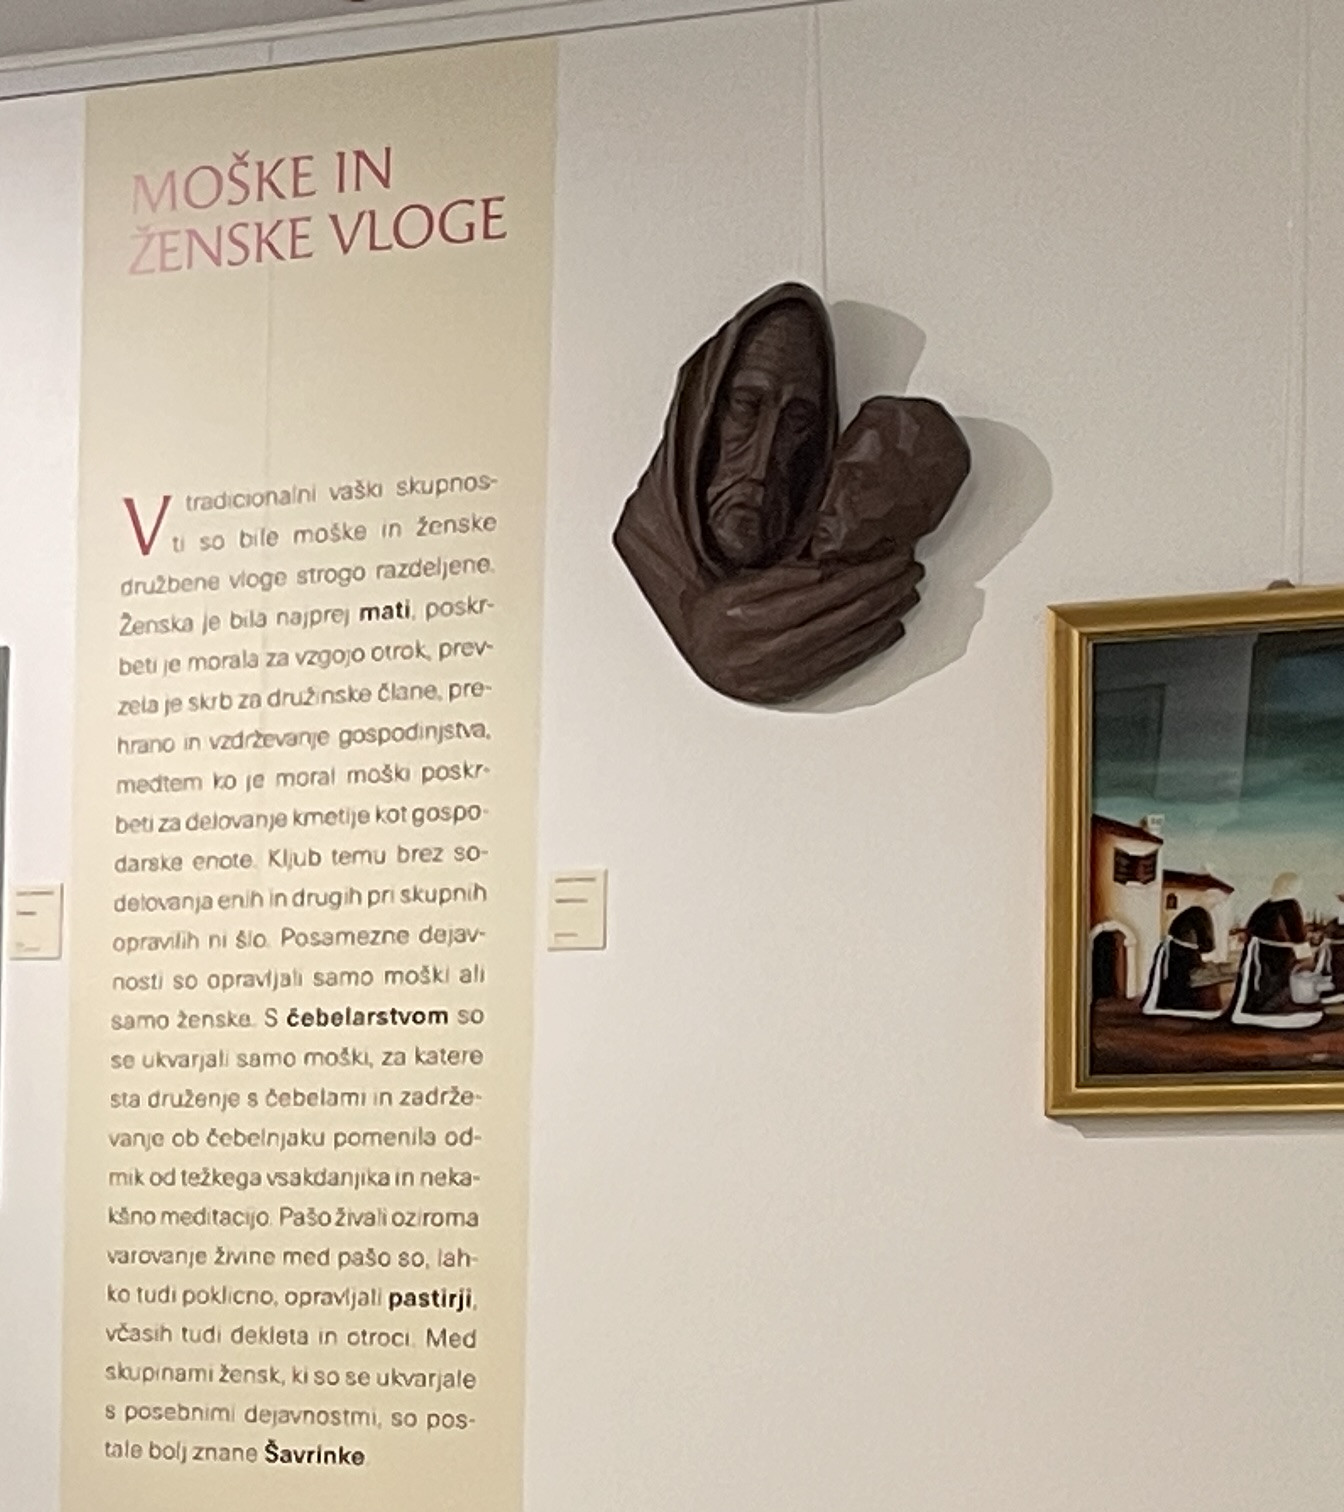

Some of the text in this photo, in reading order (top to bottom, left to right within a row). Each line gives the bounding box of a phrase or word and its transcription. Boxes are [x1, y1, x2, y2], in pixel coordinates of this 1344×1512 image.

[132, 146, 392, 215] MOŠKE IN
[128, 196, 507, 276] ŽENSKE VLOGE
[122, 474, 497, 556] V tradicionalni vaški skupnos-
[173, 512, 497, 553] ti so bile moške in ženske
[121, 574, 219, 596] družbene
[230, 570, 287, 592] vloge
[297, 565, 365, 588] strogo
[120, 611, 193, 637] Ženska
[202, 614, 220, 636] je
[230, 609, 267, 630] bila
[277, 608, 349, 630] najprej
[426, 595, 494, 623] poskr-
[120, 657, 157, 676] beti
[164, 658, 180, 676] je
[189, 649, 258, 671] morala
[266, 651, 289, 668] za
[296, 646, 365, 670] vzgojo
[439, 640, 493, 662] prev-
[118, 697, 158, 716] zela
[165, 697, 182, 718] je
[189, 691, 232, 712] skrb
[238, 692, 261, 710] za
[267, 684, 372, 708] družinske
[449, 681, 491, 703] pre-
[118, 737, 175, 755] hrano
[185, 736, 200, 750] in
[209, 729, 330, 751] vzdrževanje
[118, 759, 490, 794] medtem ko je moral moški poskr-
[116, 804, 488, 835] beti za delovanje kmetije kot gospo-
[115, 854, 182, 874] darske
[269, 847, 321, 871] Kljub
[332, 849, 386, 866] temu
[397, 844, 444, 864] brez
[454, 845, 488, 863] so-
[114, 882, 487, 915] delovanja enih in drugih pri skupnih
[113, 931, 199, 955] opravilih
[209, 934, 226, 949] ni
[282, 926, 409, 948] Posamezne
[419, 924, 485, 948] dejav-
[113, 963, 484, 993] nosti so opravljali samo moški ali
[112, 1014, 169, 1031] samo
[265, 1007, 278, 1028] S
[287, 1005, 448, 1028] čebelarstvom
[458, 1008, 484, 1026] so
[111, 1054, 134, 1070] se
[143, 1049, 228, 1073] ukvarjali
[237, 1051, 296, 1069] samo
[382, 1050, 406, 1067] za
[415, 1045, 483, 1066] katere
[111, 1085, 481, 1113] sta druženje s čebelami in zadrže-
[109, 1126, 481, 1152] vanje ob čebelnjaku pomenila od-
[109, 1166, 480, 1192] mik od težkega vsakdanjika in neka-
[109, 1206, 156, 1226] kšno
[280, 1205, 331, 1228] Pašo
[335, 1206, 387, 1228] živali
[392, 1210, 478, 1228] oziroma
[108, 1249, 207, 1269] varovanje
[214, 1245, 275, 1266] živine
[283, 1247, 330, 1267] med
[338, 1247, 391, 1271] pašo
[438, 1247, 478, 1268] lah-
[108, 1283, 130, 1304] ko
[137, 1284, 176, 1305] tudi
[285, 1286, 382, 1312] opravljali
[106, 1321, 172, 1343] včasih
[182, 1324, 221, 1344] tudi
[231, 1324, 308, 1346] dekleta
[319, 1330, 337, 1346] in
[426, 1326, 477, 1349] Med
[106, 1361, 213, 1385] skupinami
[292, 1365, 308, 1385] ki
[314, 1369, 340, 1387] so
[346, 1370, 370, 1388] se
[377, 1367, 476, 1393] ukvarjale
[106, 1404, 115, 1420] s
[125, 1402, 234, 1424] posebnimi
[392, 1411, 417, 1428] so
[427, 1412, 475, 1433] pos-
[105, 1438, 143, 1460] tale
[149, 1440, 187, 1465] bolj
[192, 1445, 257, 1464] znane
